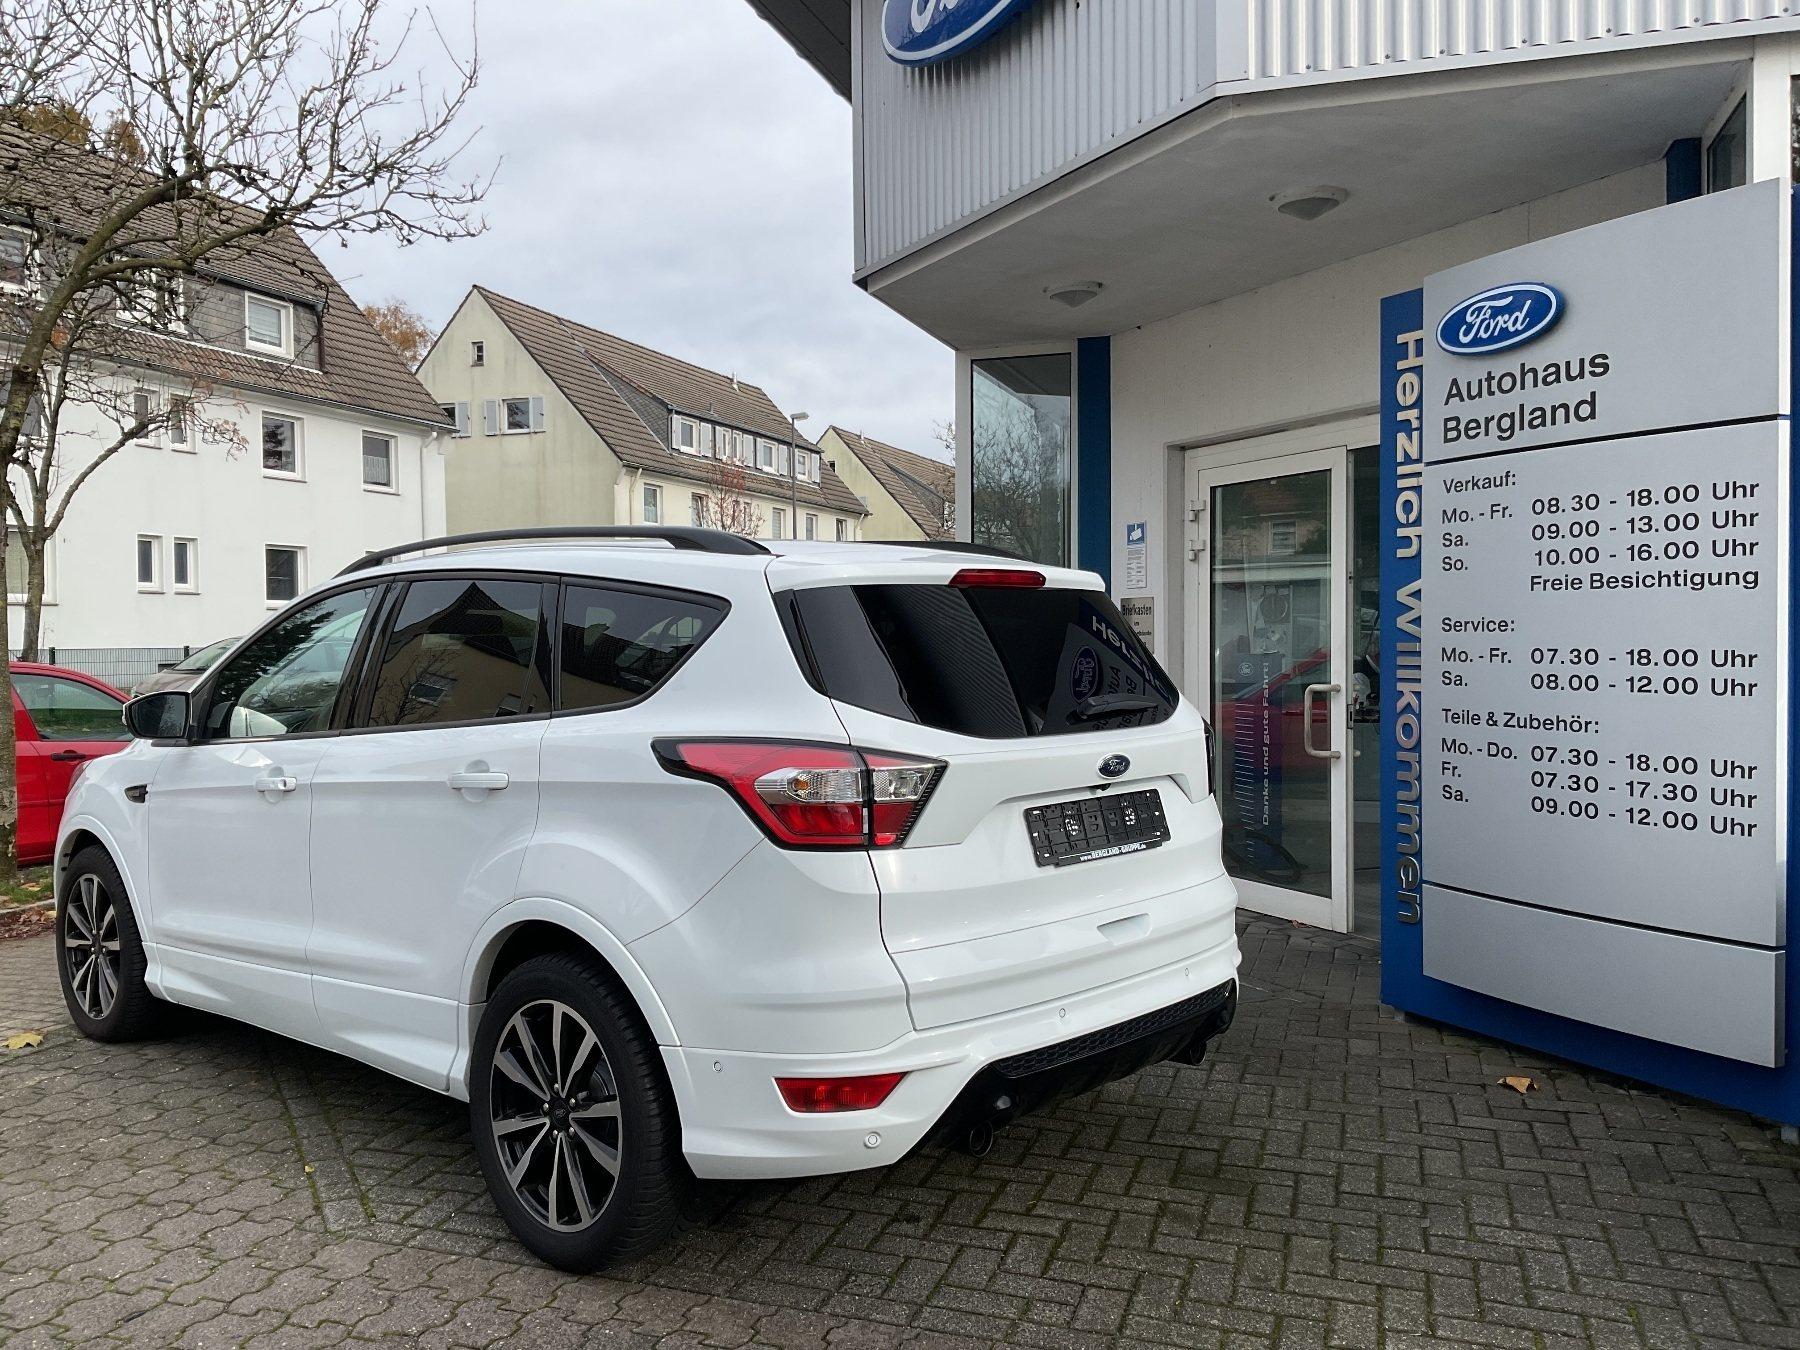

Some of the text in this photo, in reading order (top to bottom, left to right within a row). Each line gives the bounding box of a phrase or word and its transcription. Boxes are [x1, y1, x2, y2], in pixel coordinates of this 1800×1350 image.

[1458, 295, 1532, 344] Ford
[1443, 353, 1610, 406] Autohaus
[1442, 391, 1598, 444] Bergland
[1442, 470, 1516, 494] Verkauf:
[1531, 493, 1600, 516] 08.30
[1626, 484, 1700, 507] 18.00
[1712, 481, 1760, 501] Uhr
[1442, 532, 1469, 548] Sa.
[1531, 519, 1600, 541] 09.00
[1626, 512, 1700, 535] 13.00
[1712, 509, 1760, 529] Uhr
[1442, 556, 1469, 572] So.
[1534, 546, 1600, 567] 10.00
[1626, 540, 1700, 562] 16.00
[1711, 538, 1760, 558] Uhr
[1530, 569, 1759, 592] Freie Besichtigung
[1122, 603, 1152, 616] Briefkasten
[1395, 330, 1424, 924] Herzlich Willkommen
[1441, 616, 1515, 633] Service:
[1530, 647, 1599, 666] 07.30
[1625, 648, 1699, 667] 18.00
[1711, 649, 1758, 668] Uhr
[1441, 670, 1468, 687] Sa.
[1530, 673, 1600, 692] 08.00
[1625, 675, 1699, 696] 12.00
[1710, 677, 1758, 697] Uhr
[1262, 710, 1270, 745] gute
[1441, 708, 1599, 734] Teile & Zubehör:
[1262, 747, 1270, 775] und
[1530, 745, 1599, 767] 07.30
[1625, 753, 1699, 776] 18.00
[1710, 758, 1758, 780] Uhr
[1262, 779, 1270, 826] Danke
[1441, 761, 1462, 778] Fr.
[1530, 770, 1599, 794] 07.30
[1625, 780, 1698, 803] 17.30
[1710, 787, 1758, 809] Uhr
[1441, 785, 1470, 803] Sa.
[1530, 795, 1599, 820] 09.00
[1625, 806, 1698, 831] 12.00
[1710, 815, 1758, 838] Uhr
